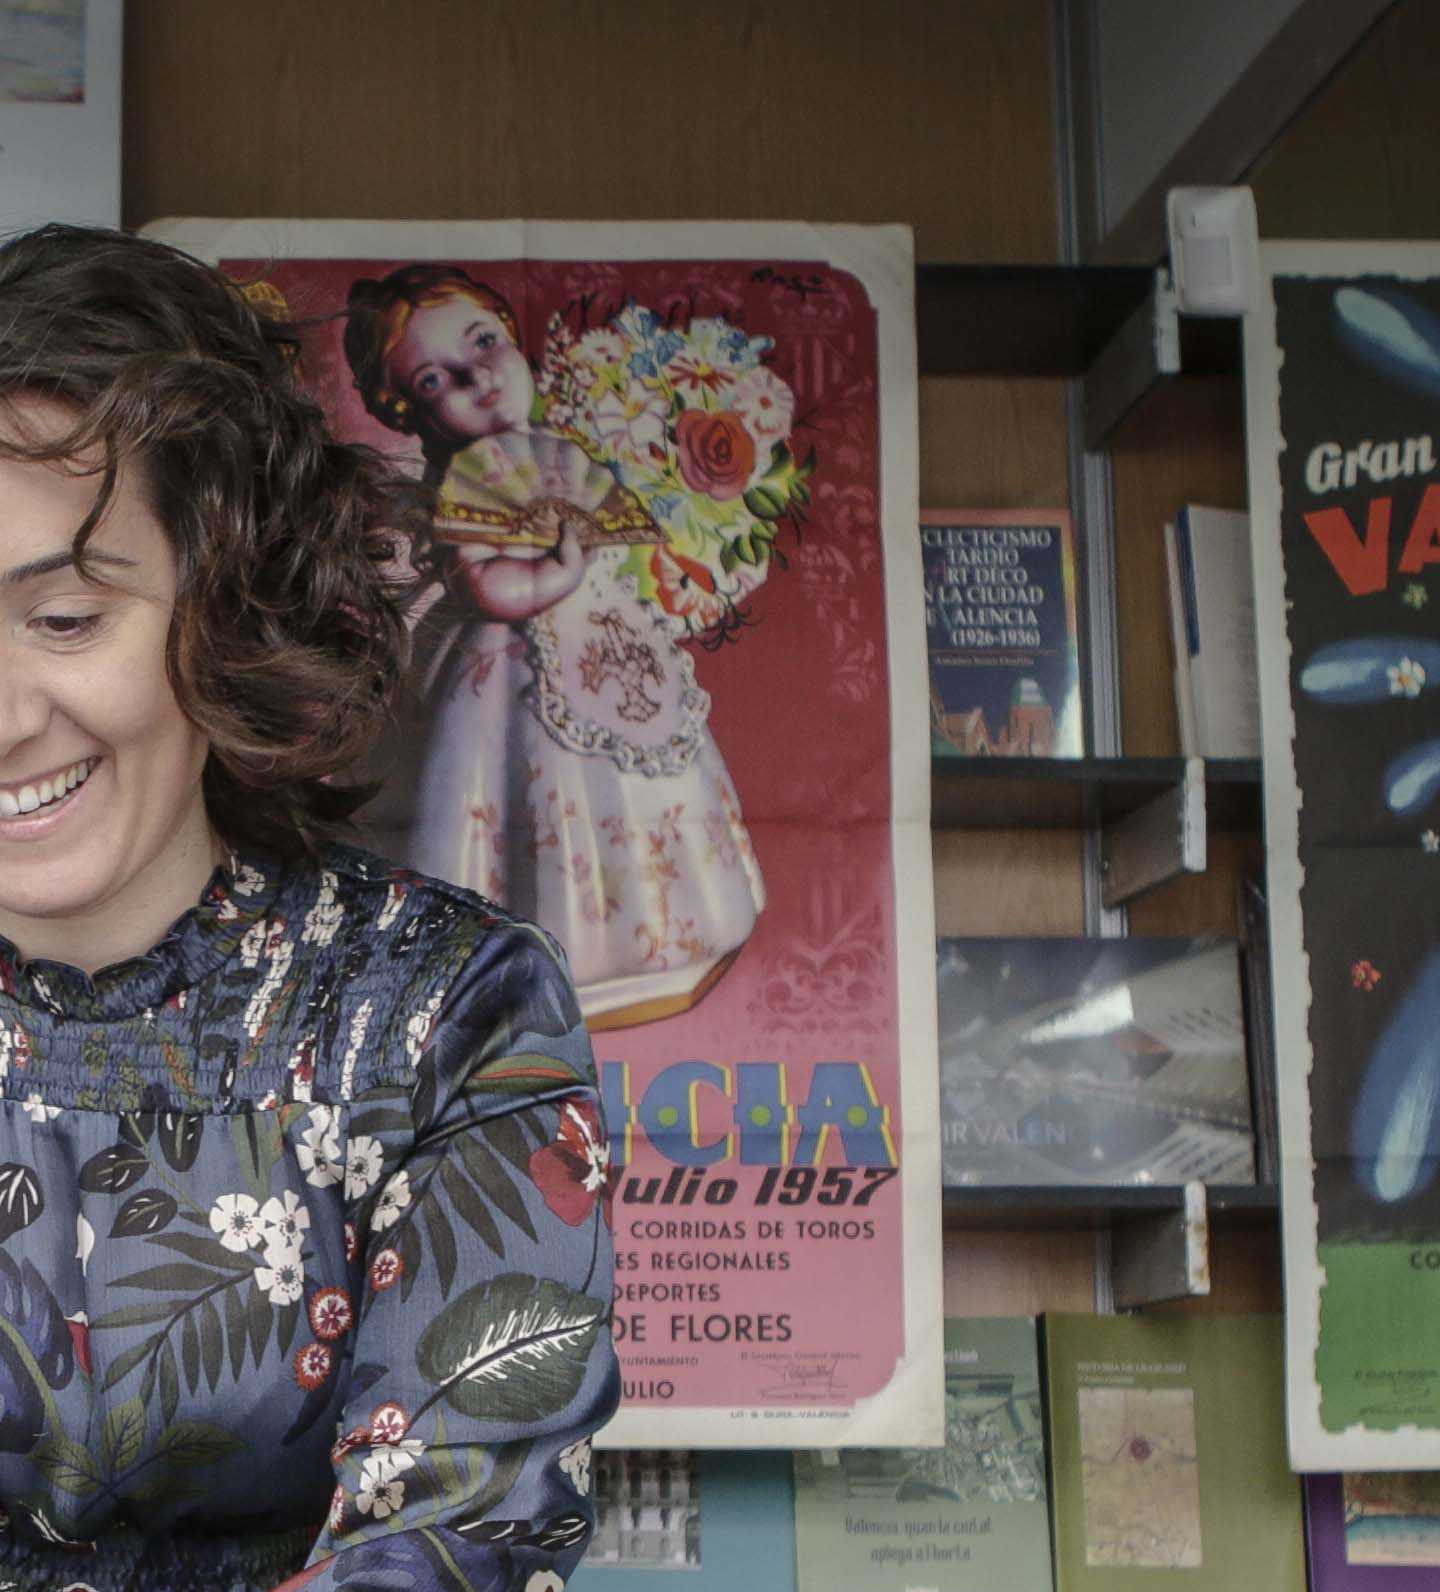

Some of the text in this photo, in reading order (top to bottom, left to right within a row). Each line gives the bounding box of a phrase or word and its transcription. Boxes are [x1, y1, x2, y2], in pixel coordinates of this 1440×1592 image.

[1306, 434, 1436, 495] Gran
[923, 528, 1052, 547] CLECTICISMO
[754, 1165, 899, 1207] 1957
[630, 1219, 876, 1241] CORRIDAS DE TOROS
[650, 1251, 791, 1272] REGIONALES
[670, 1312, 794, 1343] FLORES
[620, 1355, 699, 1367] YUNTAMIENTO
